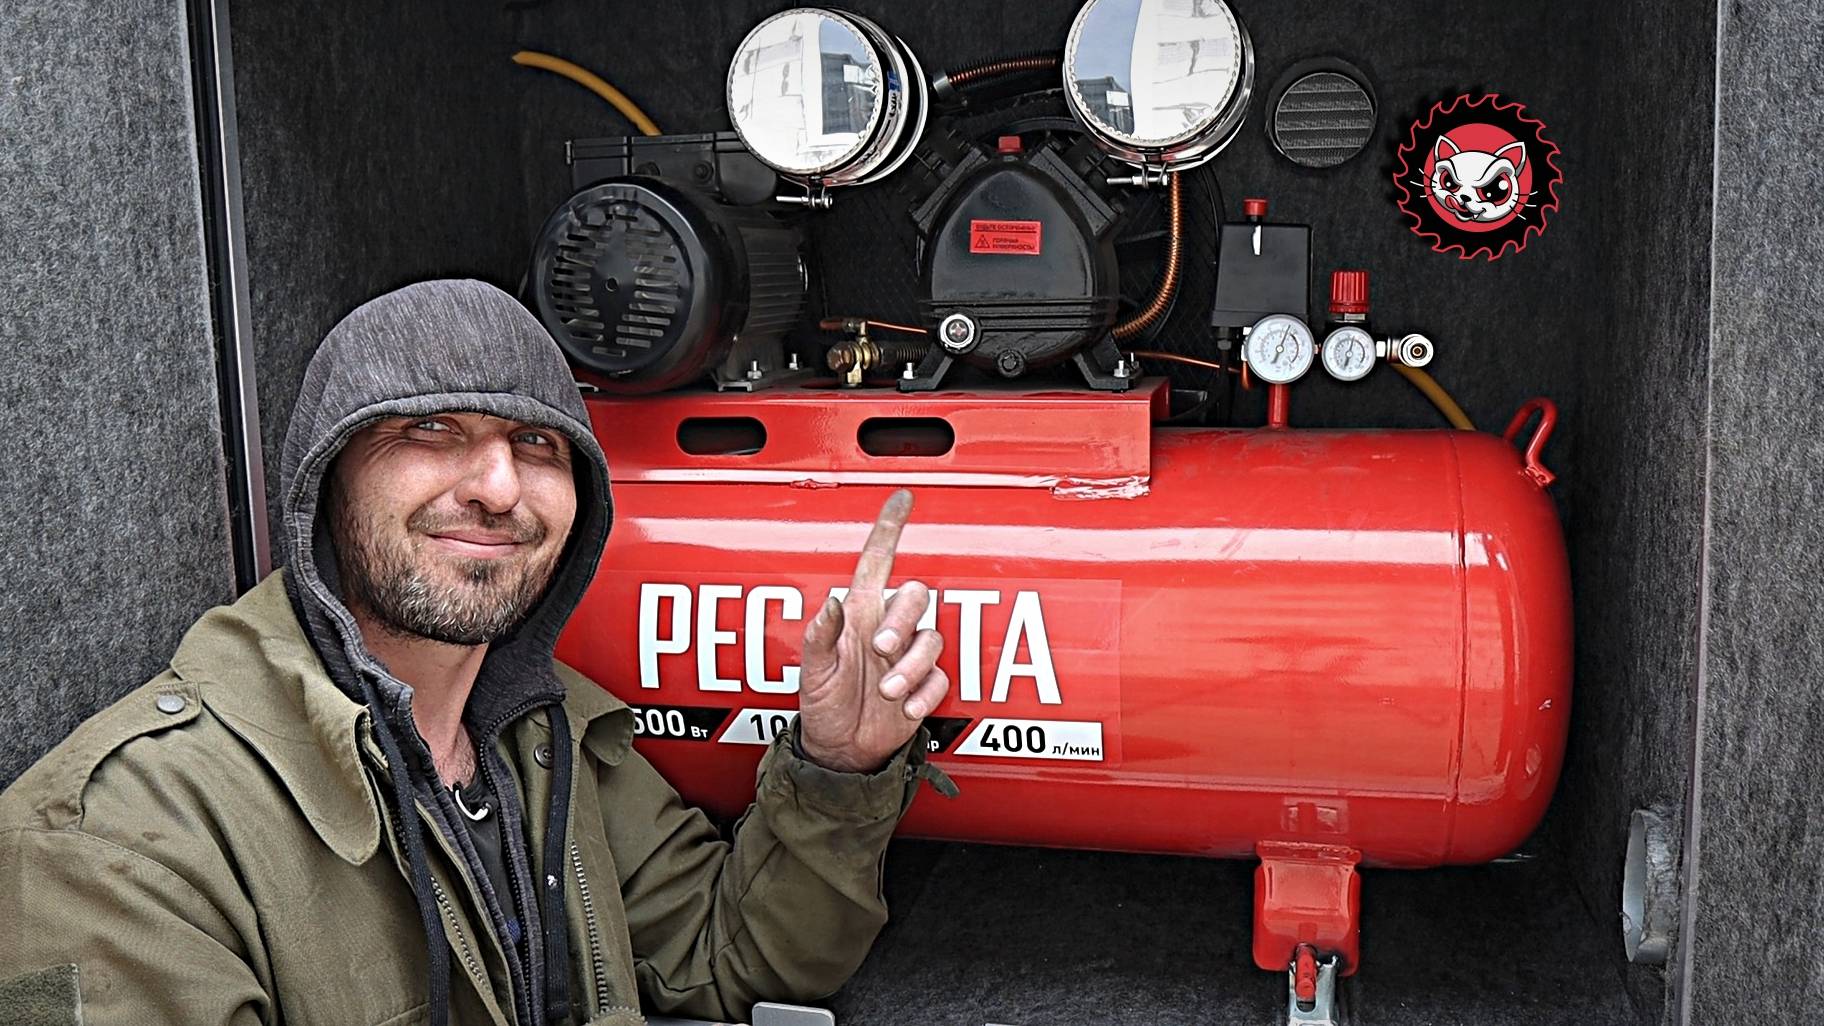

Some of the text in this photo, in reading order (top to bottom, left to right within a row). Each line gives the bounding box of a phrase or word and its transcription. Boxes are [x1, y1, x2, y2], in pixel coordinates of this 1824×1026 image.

[639, 582, 1063, 705] РЕСТА
[690, 725, 708, 739] Вт
[979, 723, 1047, 754] 400
[1052, 742, 1101, 757] л/мин
